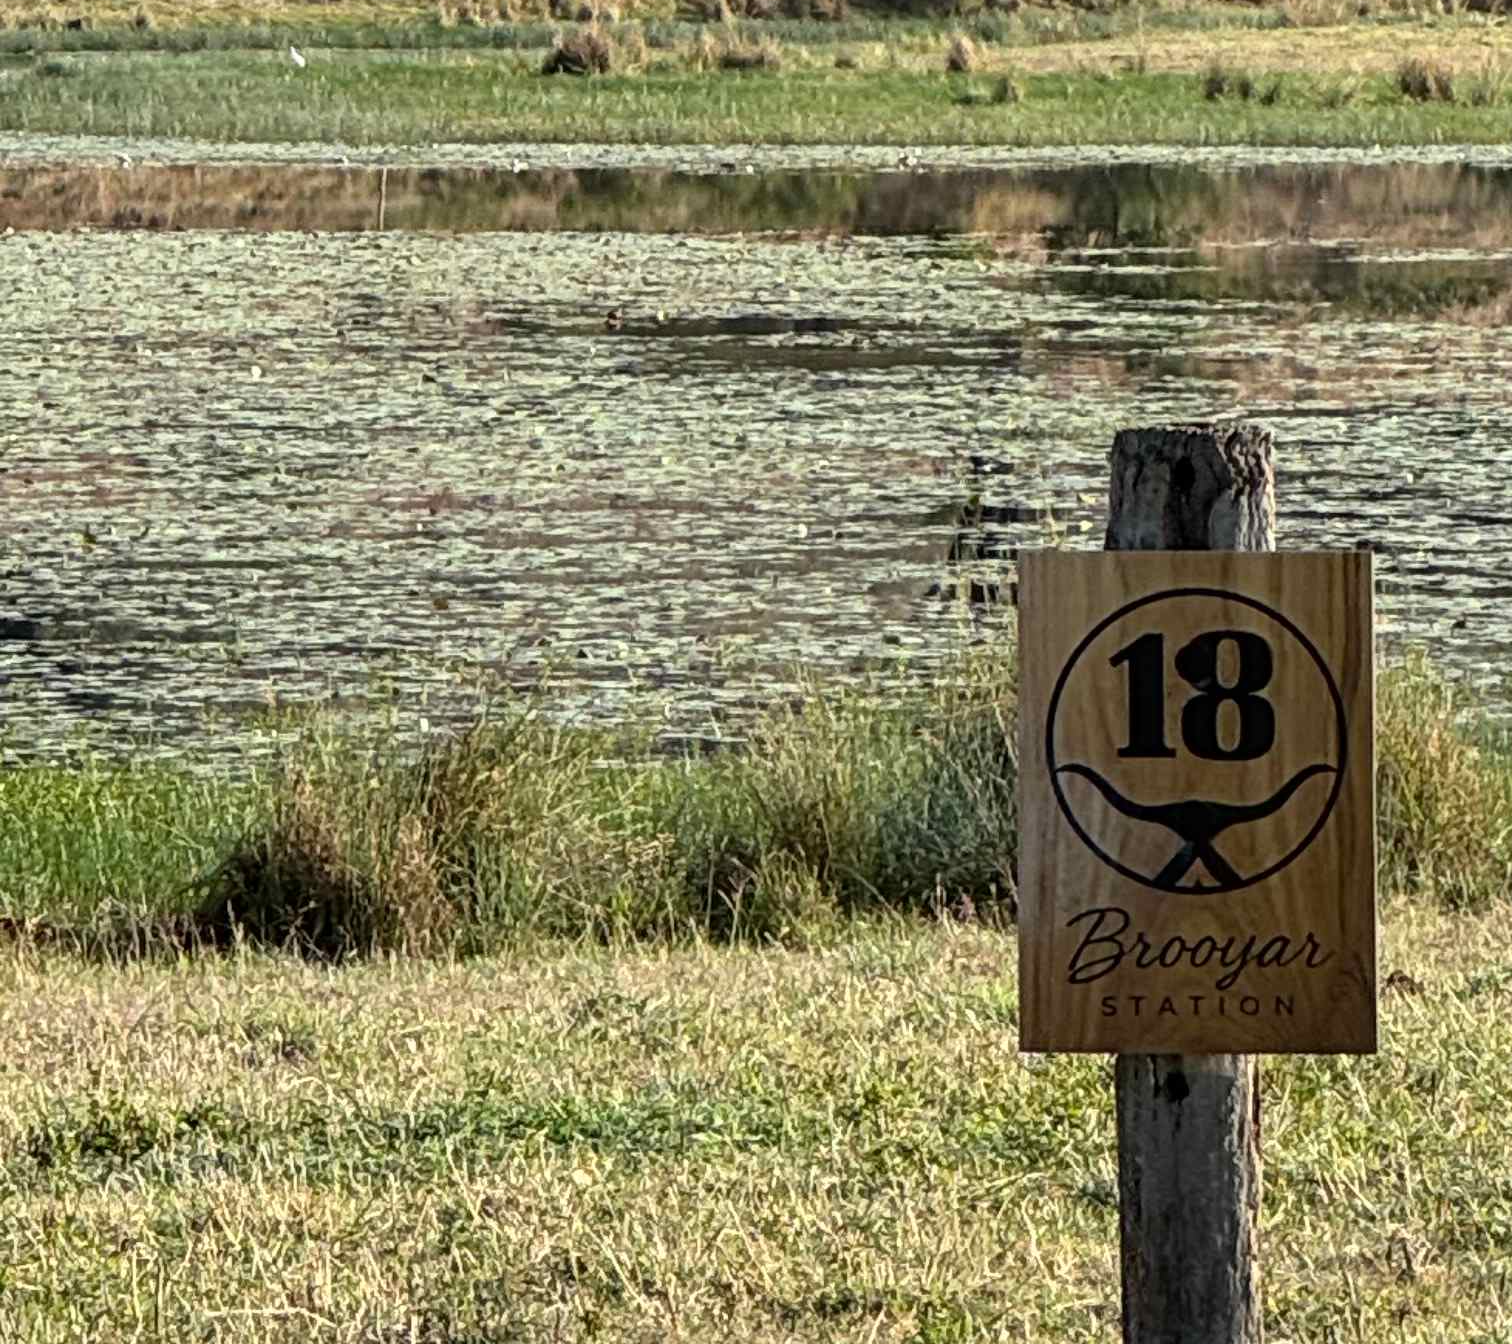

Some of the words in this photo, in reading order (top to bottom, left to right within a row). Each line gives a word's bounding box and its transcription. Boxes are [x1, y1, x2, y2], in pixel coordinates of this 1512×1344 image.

[1108, 629, 1275, 761] 18
[1066, 907, 1334, 990] Brooyar
[1101, 995, 1295, 1017] STATION
